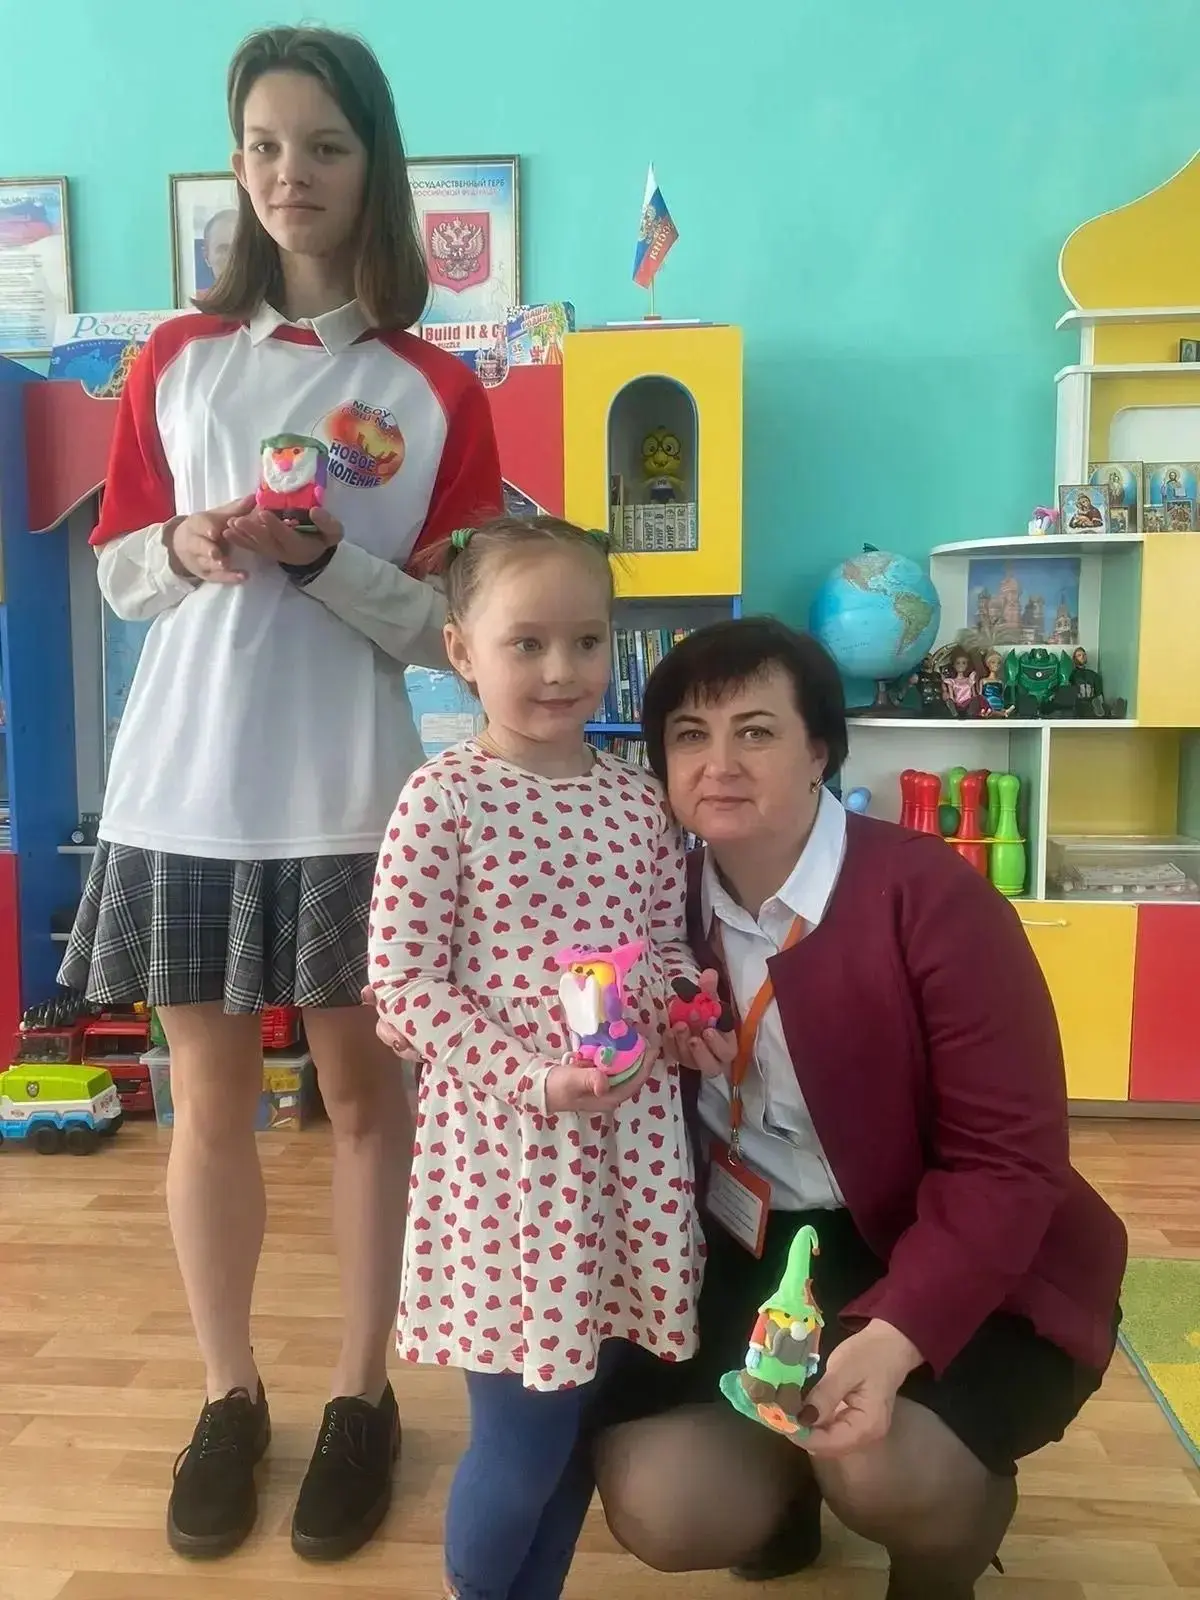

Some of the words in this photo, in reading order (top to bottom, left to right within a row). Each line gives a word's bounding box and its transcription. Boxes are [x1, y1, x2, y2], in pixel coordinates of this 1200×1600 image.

[488, 178, 505, 187] ГЕРБ
[72, 315, 152, 338] Росс
[425, 325, 461, 342] Build
[466, 325, 477, 340] It
[478, 324, 489, 338] &
[353, 400, 391, 418] МБОУ
[329, 441, 377, 472] НОВОЕ
[328, 458, 383, 488] КОЛЕНИЕ
